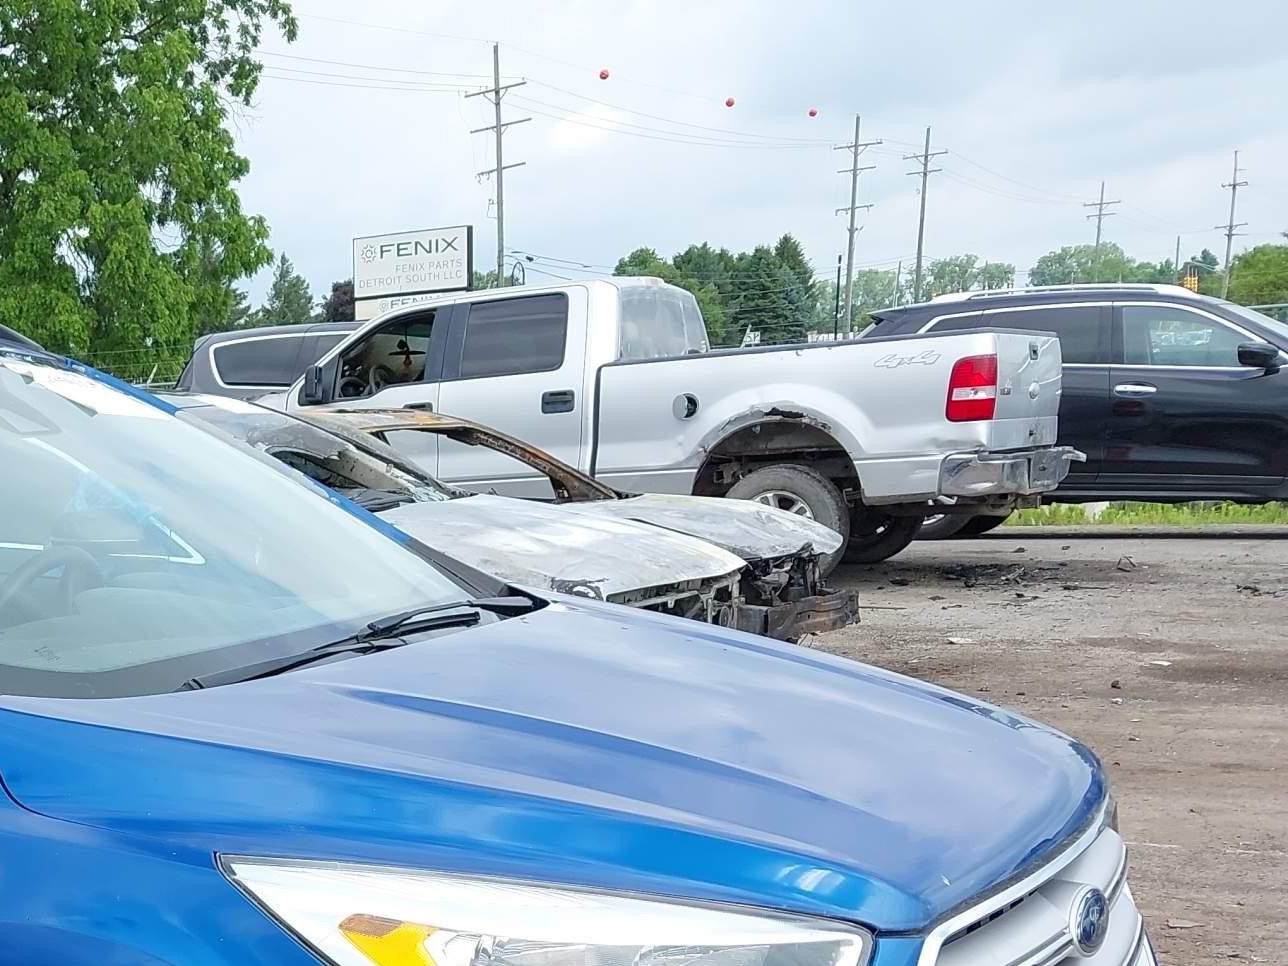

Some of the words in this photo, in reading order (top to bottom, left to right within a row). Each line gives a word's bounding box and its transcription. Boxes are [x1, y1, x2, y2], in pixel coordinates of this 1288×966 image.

[380, 236, 458, 258] FENIX
[395, 263, 425, 273] FENIX
[428, 258, 463, 270] PARTS
[359, 275, 402, 288] DETROIT
[405, 271, 440, 283] SOUTH
[443, 269, 463, 280] LLC
